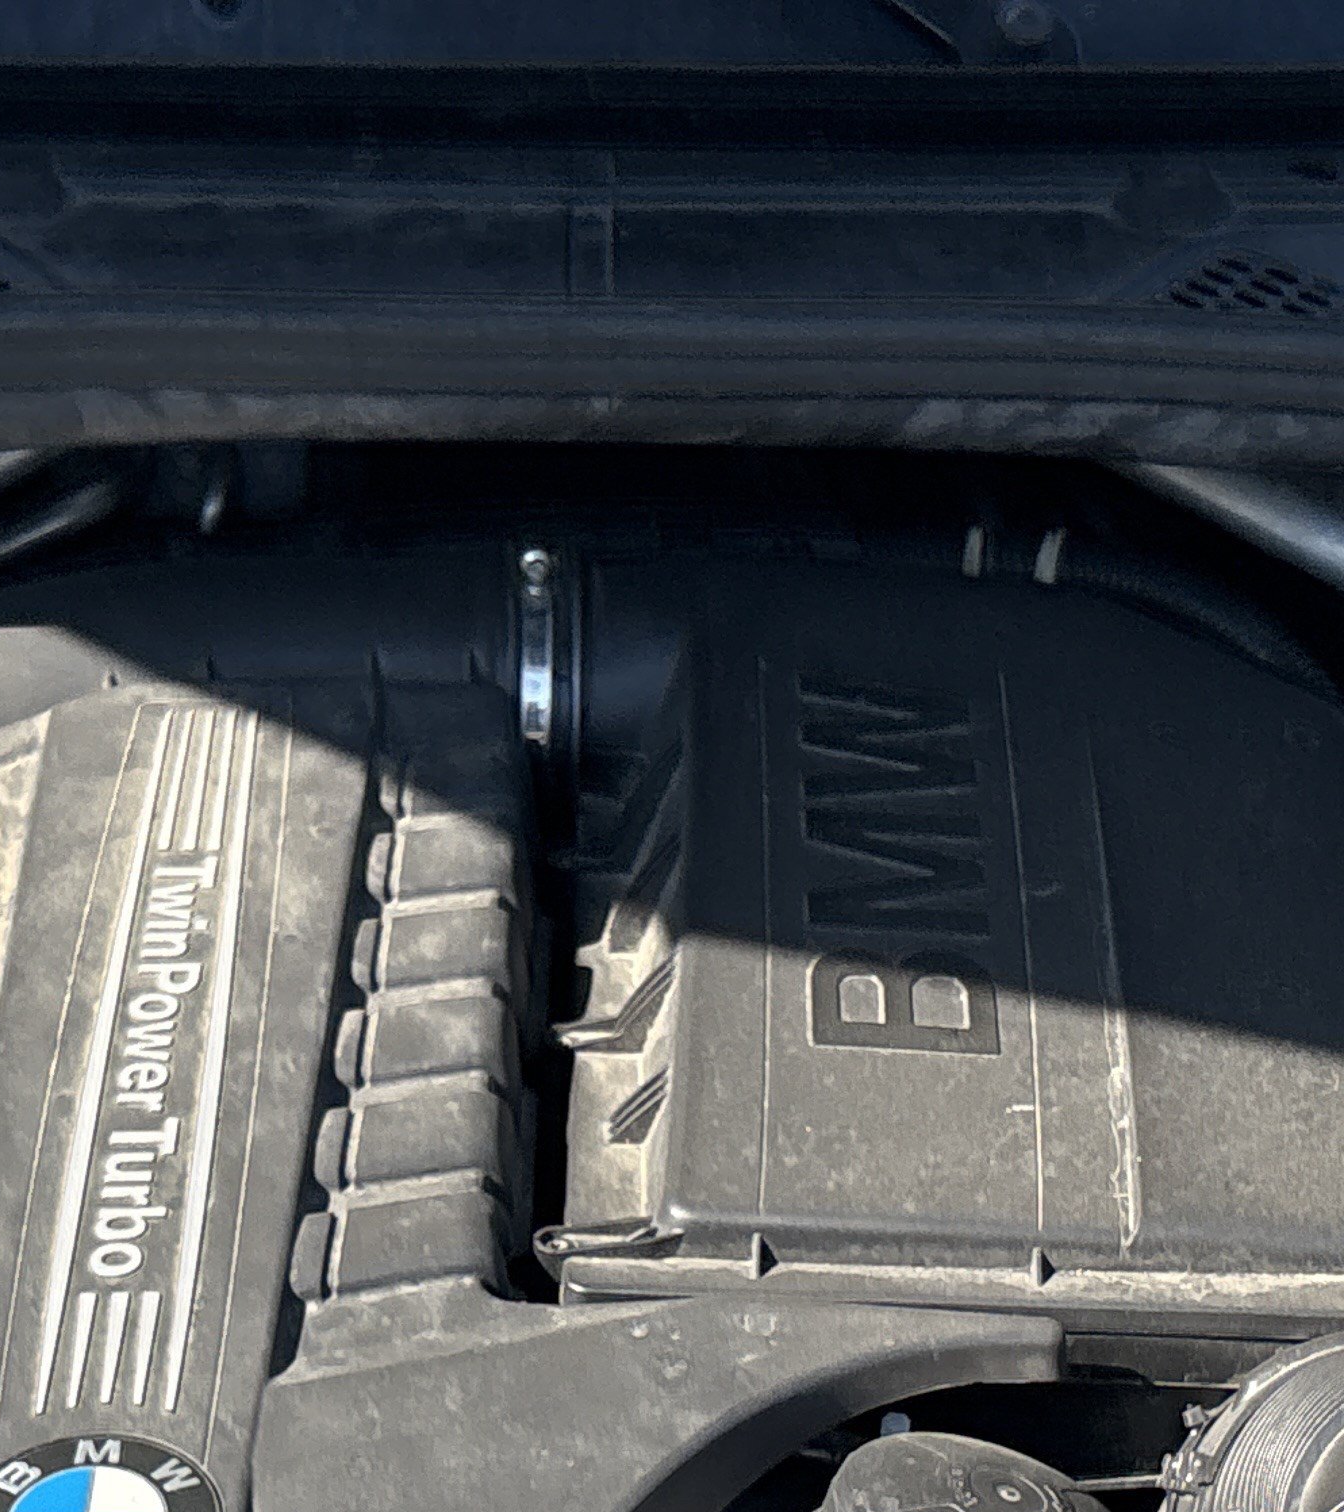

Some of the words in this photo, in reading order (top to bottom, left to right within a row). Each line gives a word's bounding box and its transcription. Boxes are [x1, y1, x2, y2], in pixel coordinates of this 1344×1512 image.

[115, 855, 219, 1113] TwinPower
[796, 669, 1002, 1058] BMW
[88, 1116, 181, 1278] Turbo
